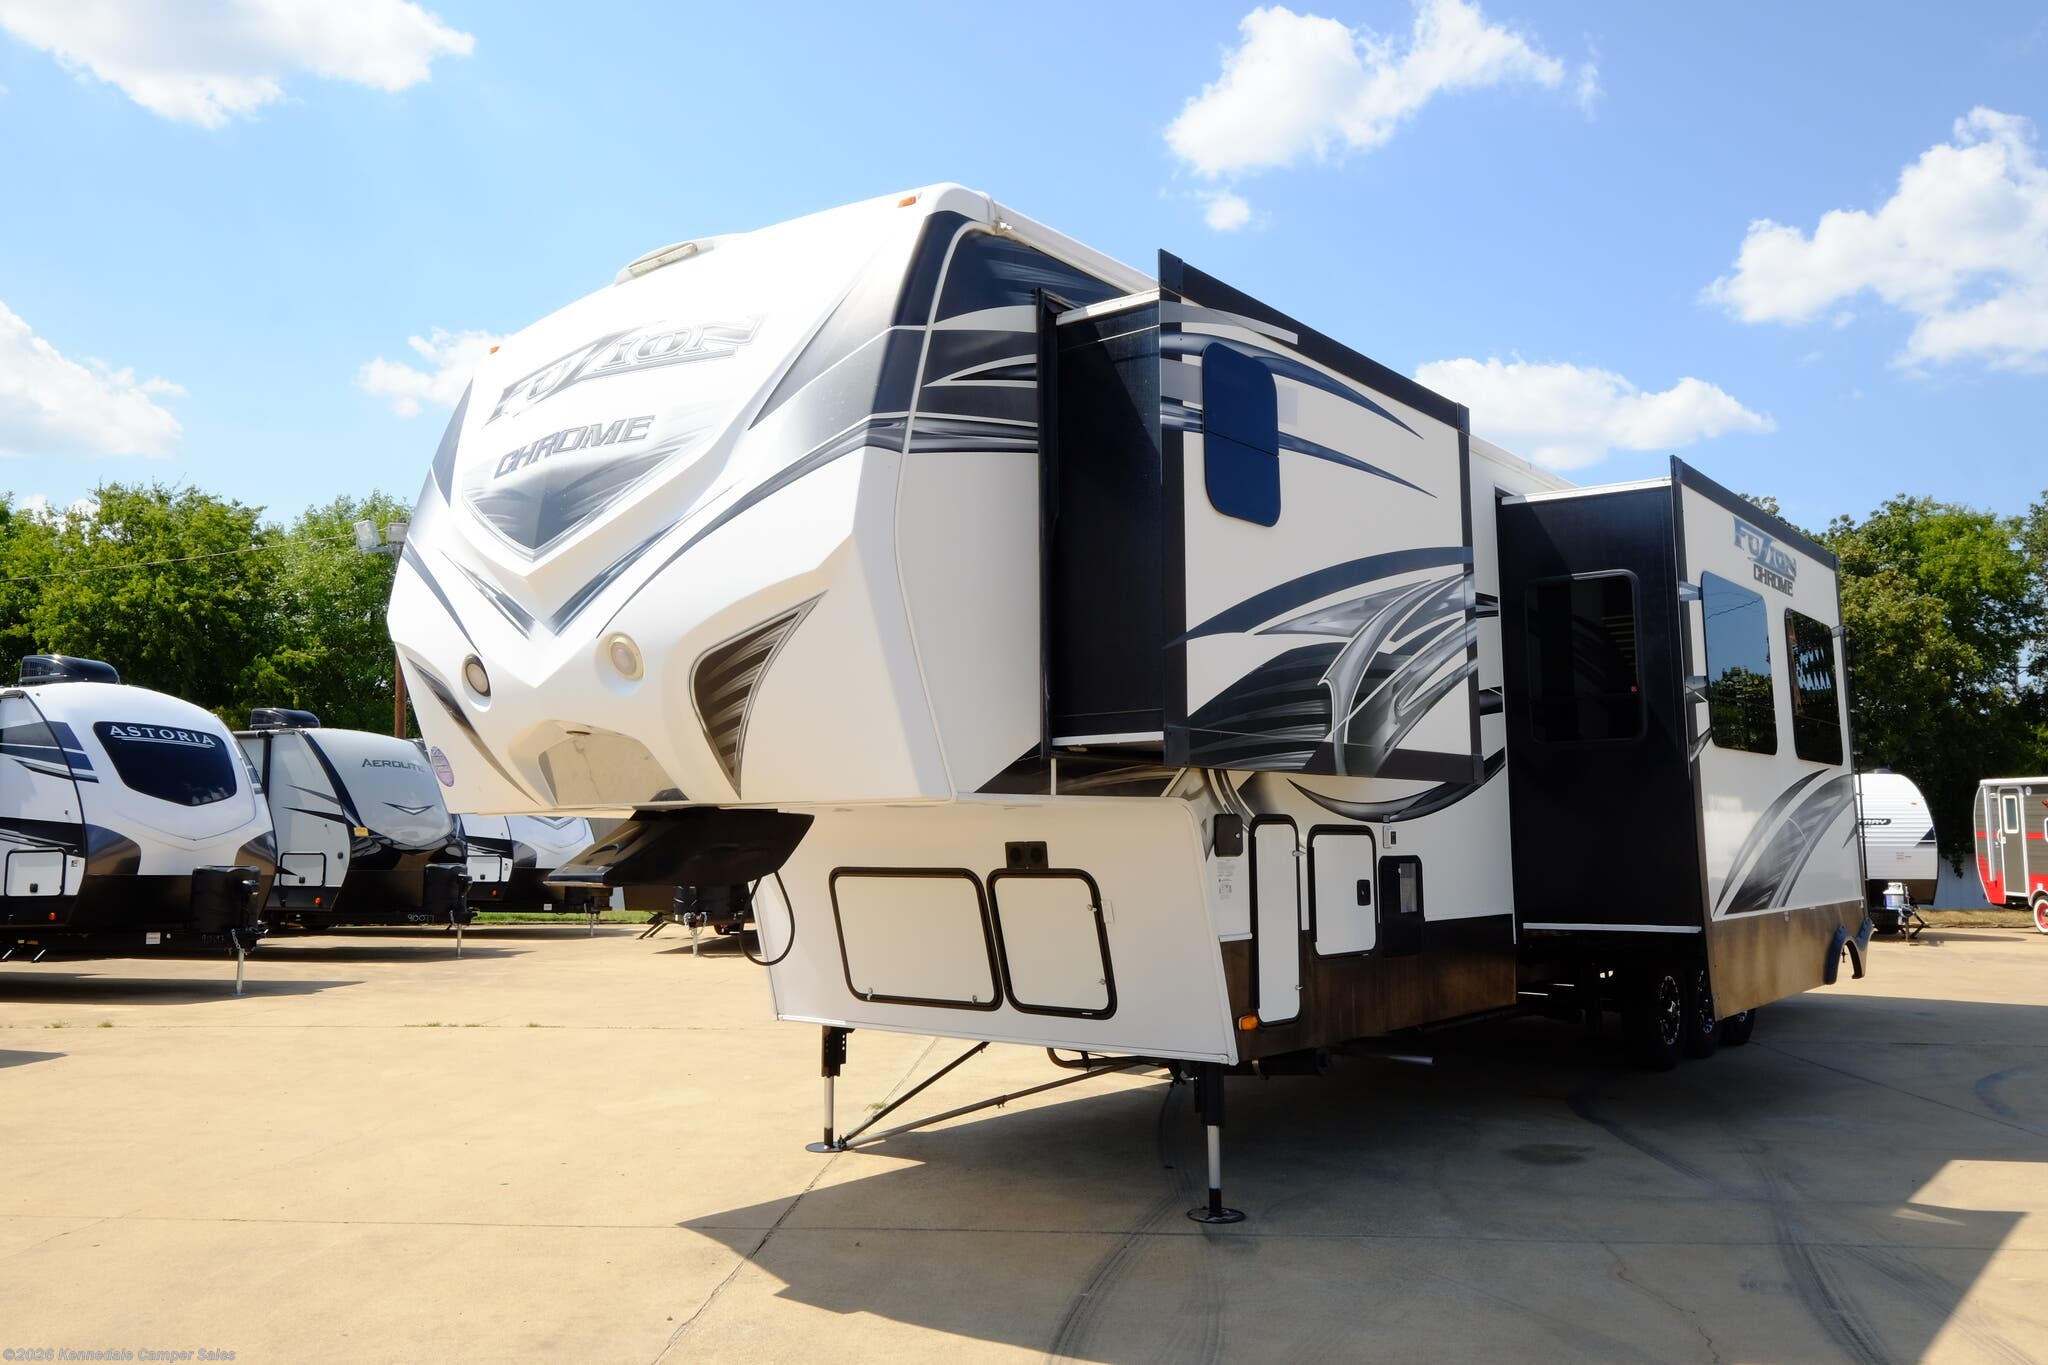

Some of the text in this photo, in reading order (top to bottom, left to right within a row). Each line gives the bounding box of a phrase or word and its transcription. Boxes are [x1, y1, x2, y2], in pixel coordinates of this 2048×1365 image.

[494, 414, 655, 479] CHROME
[1733, 516, 1797, 580] FUZION
[1753, 563, 1794, 597] CHROME
[110, 725, 216, 746] ASTORIA
[361, 758, 426, 773] AEROLITE
